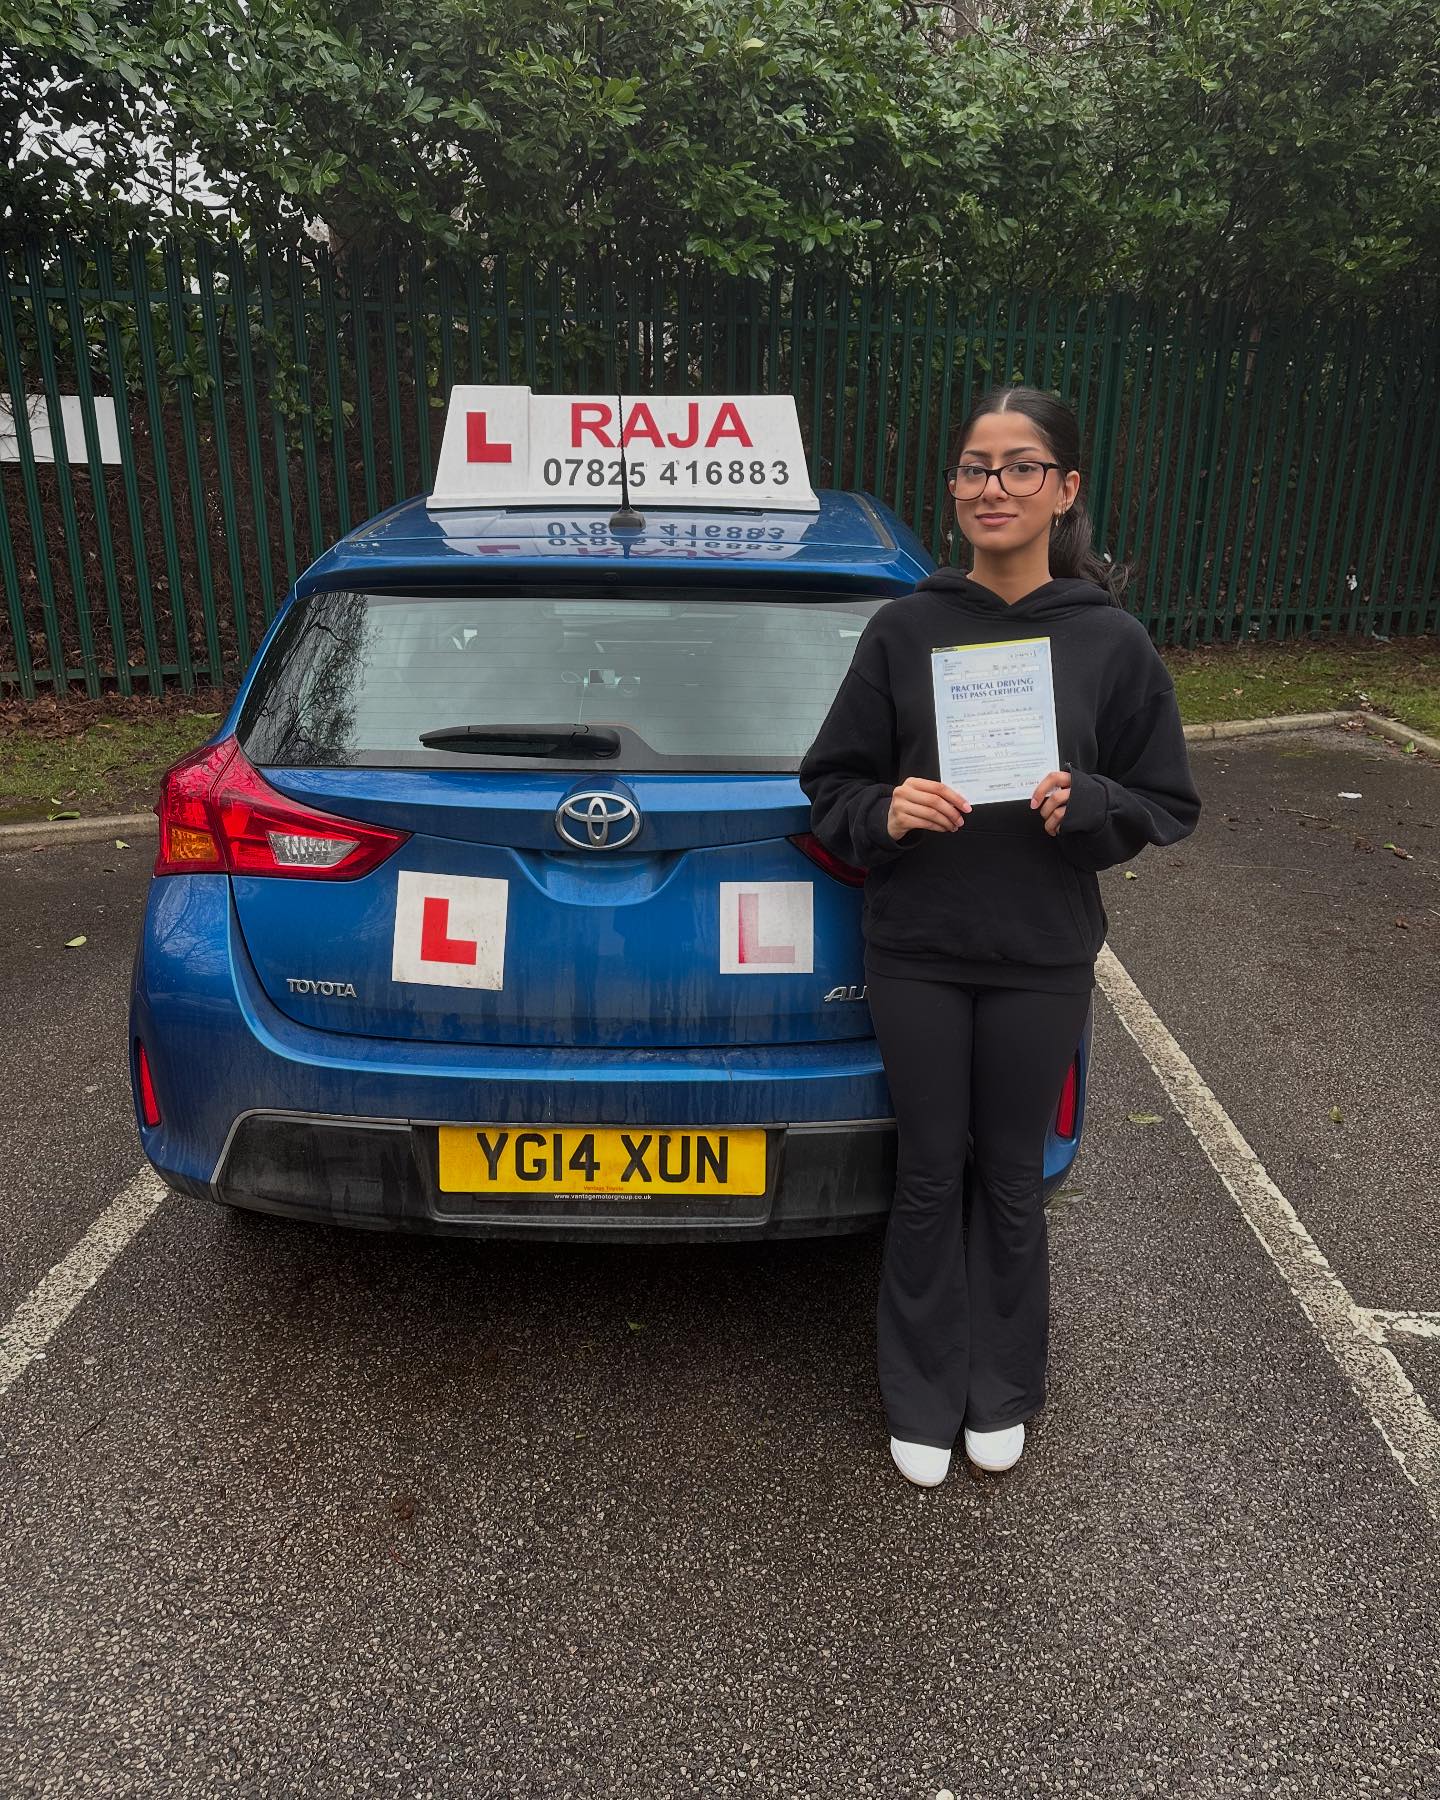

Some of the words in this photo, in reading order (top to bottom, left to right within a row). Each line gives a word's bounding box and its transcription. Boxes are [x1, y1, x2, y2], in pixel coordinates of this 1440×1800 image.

[466, 411, 512, 463] L
[570, 402, 754, 448] RAJA
[543, 458, 646, 487] 07825
[659, 459, 790, 486] 416883
[951, 681, 995, 693] PRACTICAL
[997, 677, 1034, 688] DRIVING
[952, 692, 968, 701] TEST
[970, 690, 987, 699] PASS
[988, 685, 1034, 697] CERTIFICATE
[420, 896, 478, 966] L
[738, 893, 795, 964] L
[286, 978, 358, 998] TOYOTA
[476, 1132, 601, 1182] YG14
[620, 1134, 729, 1184] XUN
[553, 1193, 652, 1201] www.vantagemotorgroup.co.uk
